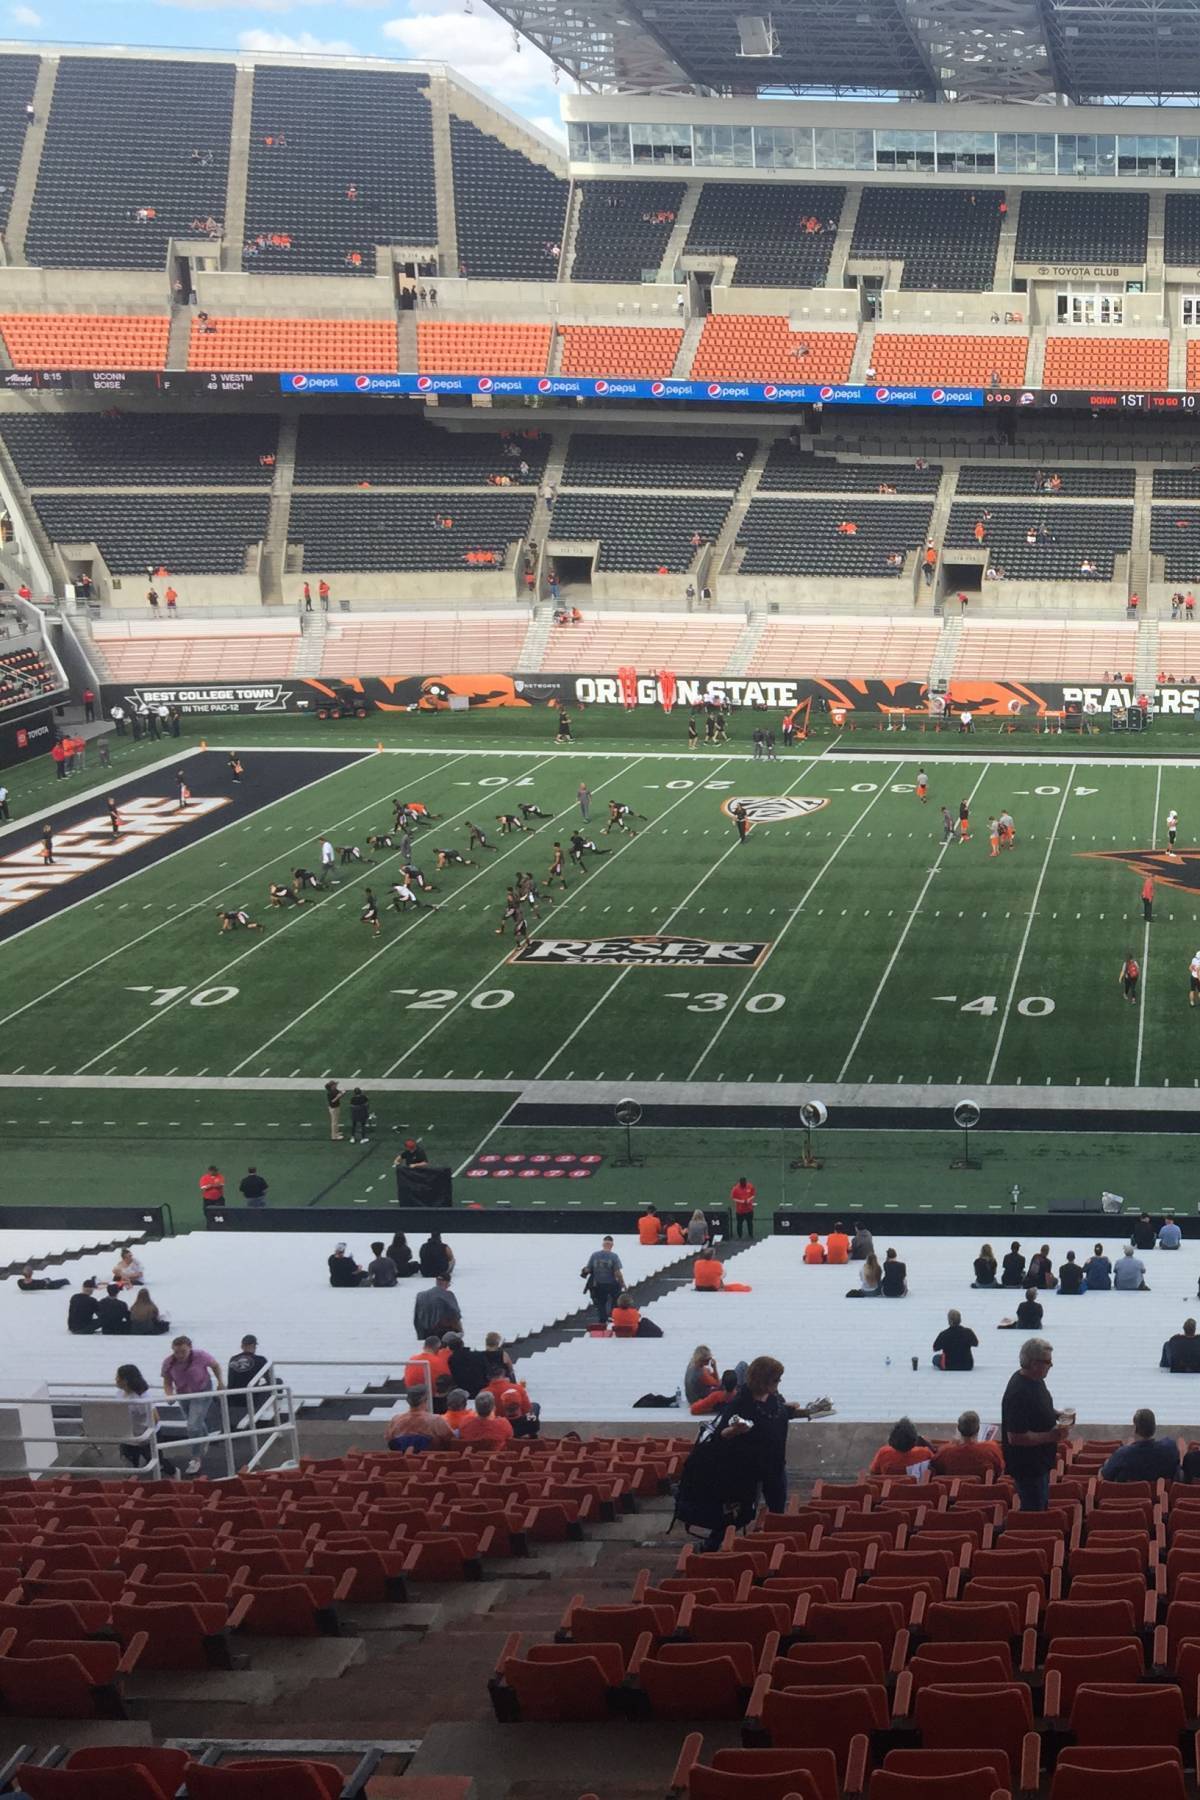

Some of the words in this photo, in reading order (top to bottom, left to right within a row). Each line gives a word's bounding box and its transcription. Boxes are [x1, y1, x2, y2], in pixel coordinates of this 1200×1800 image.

[1053, 267, 1090, 276] TOYOTA
[1094, 268, 1119, 276] CLUB
[43, 373, 62, 381] 8:15
[93, 373, 125, 381] UCONN
[221, 374, 253, 382] WESTM
[309, 377, 338, 388] pepsi
[94, 382, 121, 390] BOISE
[222, 382, 244, 390] MICH
[372, 378, 400, 390] pepsi
[433, 380, 462, 391] pepsi
[494, 381, 522, 393] pepsi
[553, 382, 580, 394] pepsi
[610, 384, 636, 395] pepsi
[666, 385, 692, 396] pepsi
[721, 386, 749, 398] pepsi
[778, 387, 805, 399] pepsi
[834, 389, 860, 400] pepsi
[890, 390, 916, 401] pepsi
[946, 391, 972, 403] pepsi
[1050, 394, 1058, 405] 0
[1120, 395, 1144, 406] 1ST
[1181, 396, 1194, 407] 10
[144, 691, 176, 702] BEST
[180, 690, 234, 700] COLLEGE
[236, 689, 274, 700] TOWN
[707, 681, 798, 706] STATE
[210, 704, 240, 712] PAC-12
[28, 726, 49, 741] TOYOTA
[526, 940, 754, 960] RESER
[150, 986, 240, 1006] 10
[405, 989, 516, 1010] 20
[687, 992, 786, 1013] 30
[960, 996, 1056, 1016] 40
